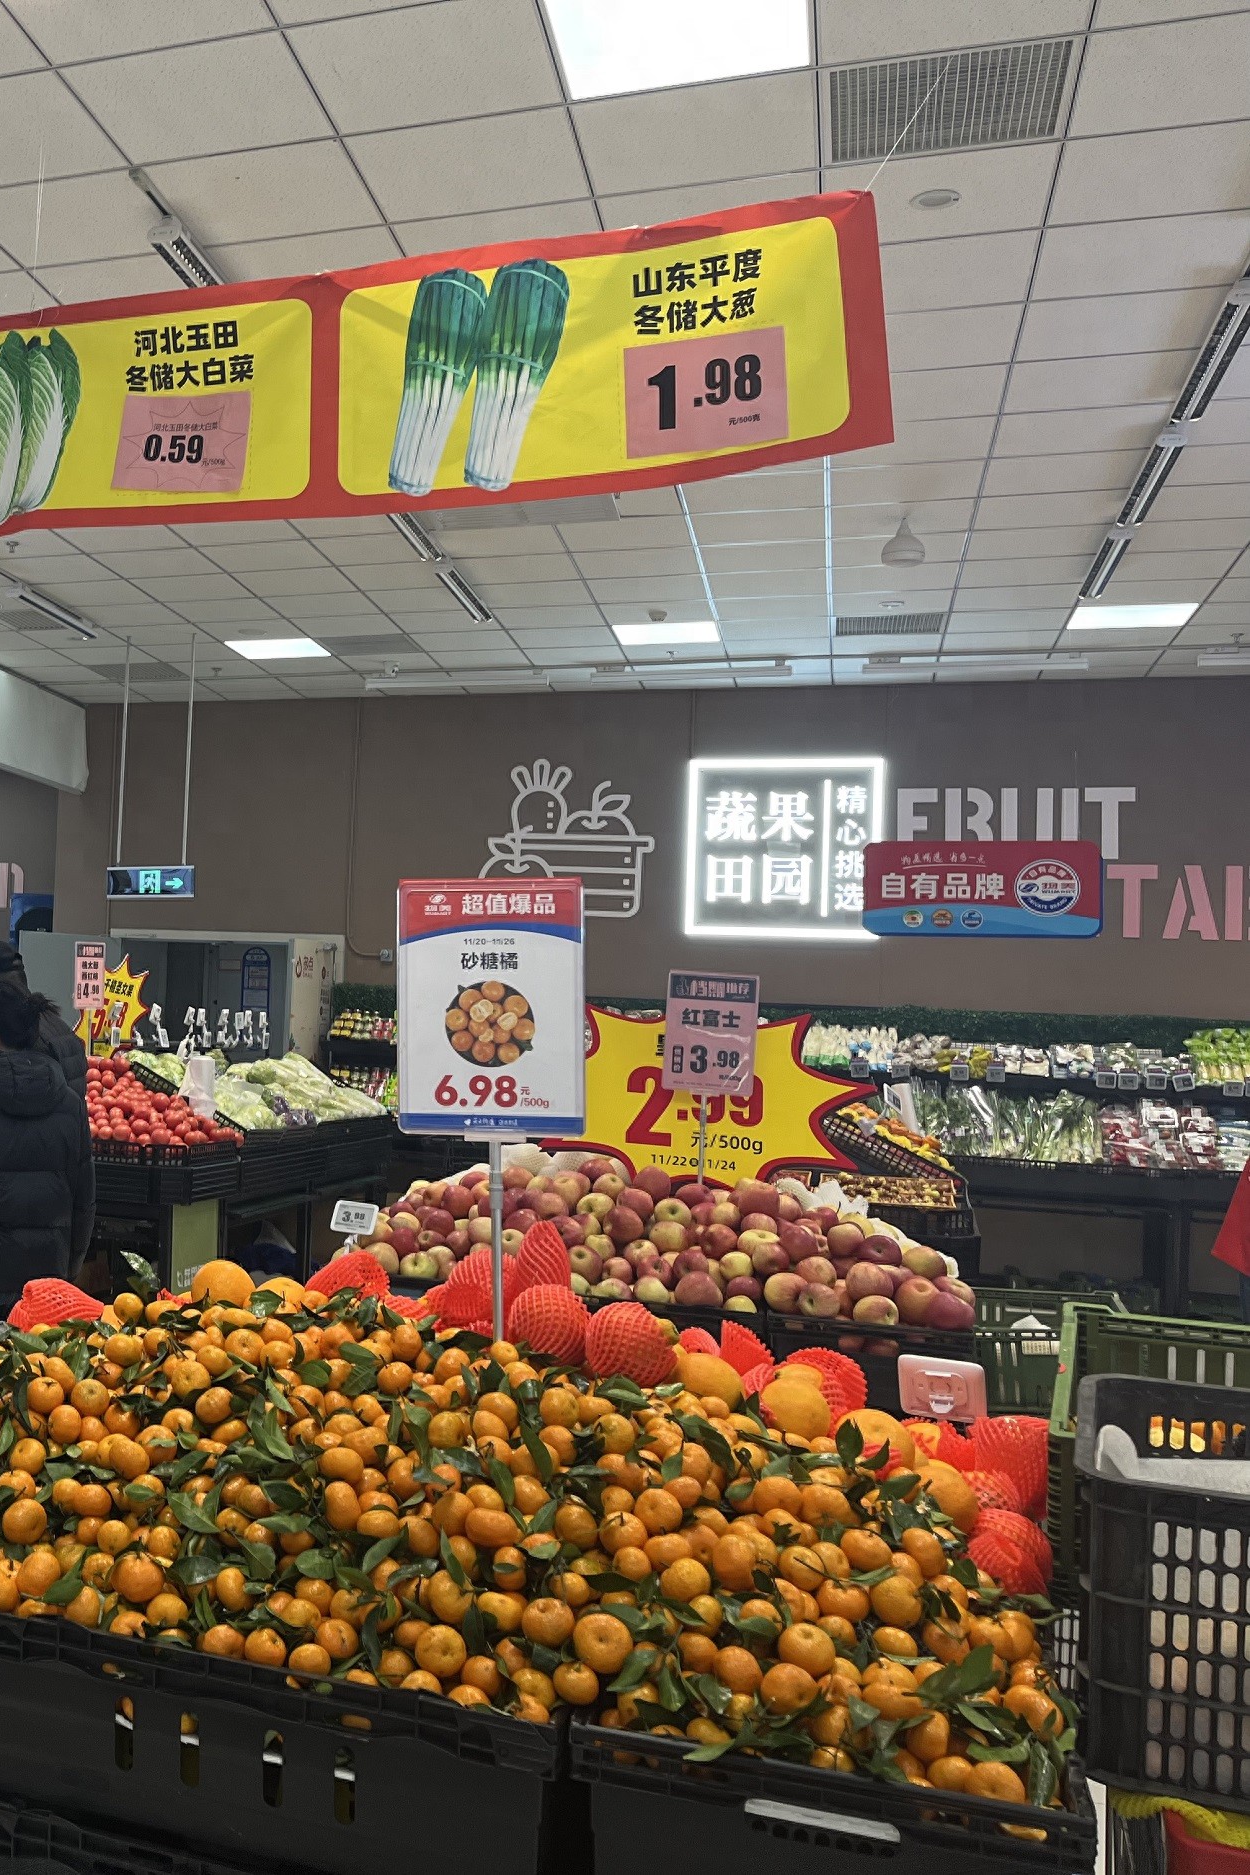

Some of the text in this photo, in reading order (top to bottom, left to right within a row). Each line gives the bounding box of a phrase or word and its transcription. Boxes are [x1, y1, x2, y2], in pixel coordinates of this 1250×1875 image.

[633, 248, 762, 298] 山东平度
[634, 287, 757, 335] 冬储大葱
[134, 320, 239, 357] 河北玉田
[125, 354, 254, 392] 冬储大白菜
[647, 353, 762, 431] 1.98
[144, 434, 204, 464] 0.59
[705, 790, 815, 842] 蔬果
[897, 787, 1136, 859] FRUIT
[834, 785, 867, 911] 精心挑选
[706, 853, 814, 905] 田园
[881, 872, 1005, 900] 自有品牌
[461, 893, 556, 915] 超值爆品
[1107, 864, 1250, 941] TA
[461, 952, 519, 970] 砂糖橘
[681, 1007, 741, 1028] 红富士
[690, 1045, 740, 1074] 3.98
[434, 1075, 518, 1107] 6.98
[520, 1086, 530, 1095] 元
[691, 1132, 763, 1154] 元/500g
[651, 1154, 737, 1171] 11/221/24
